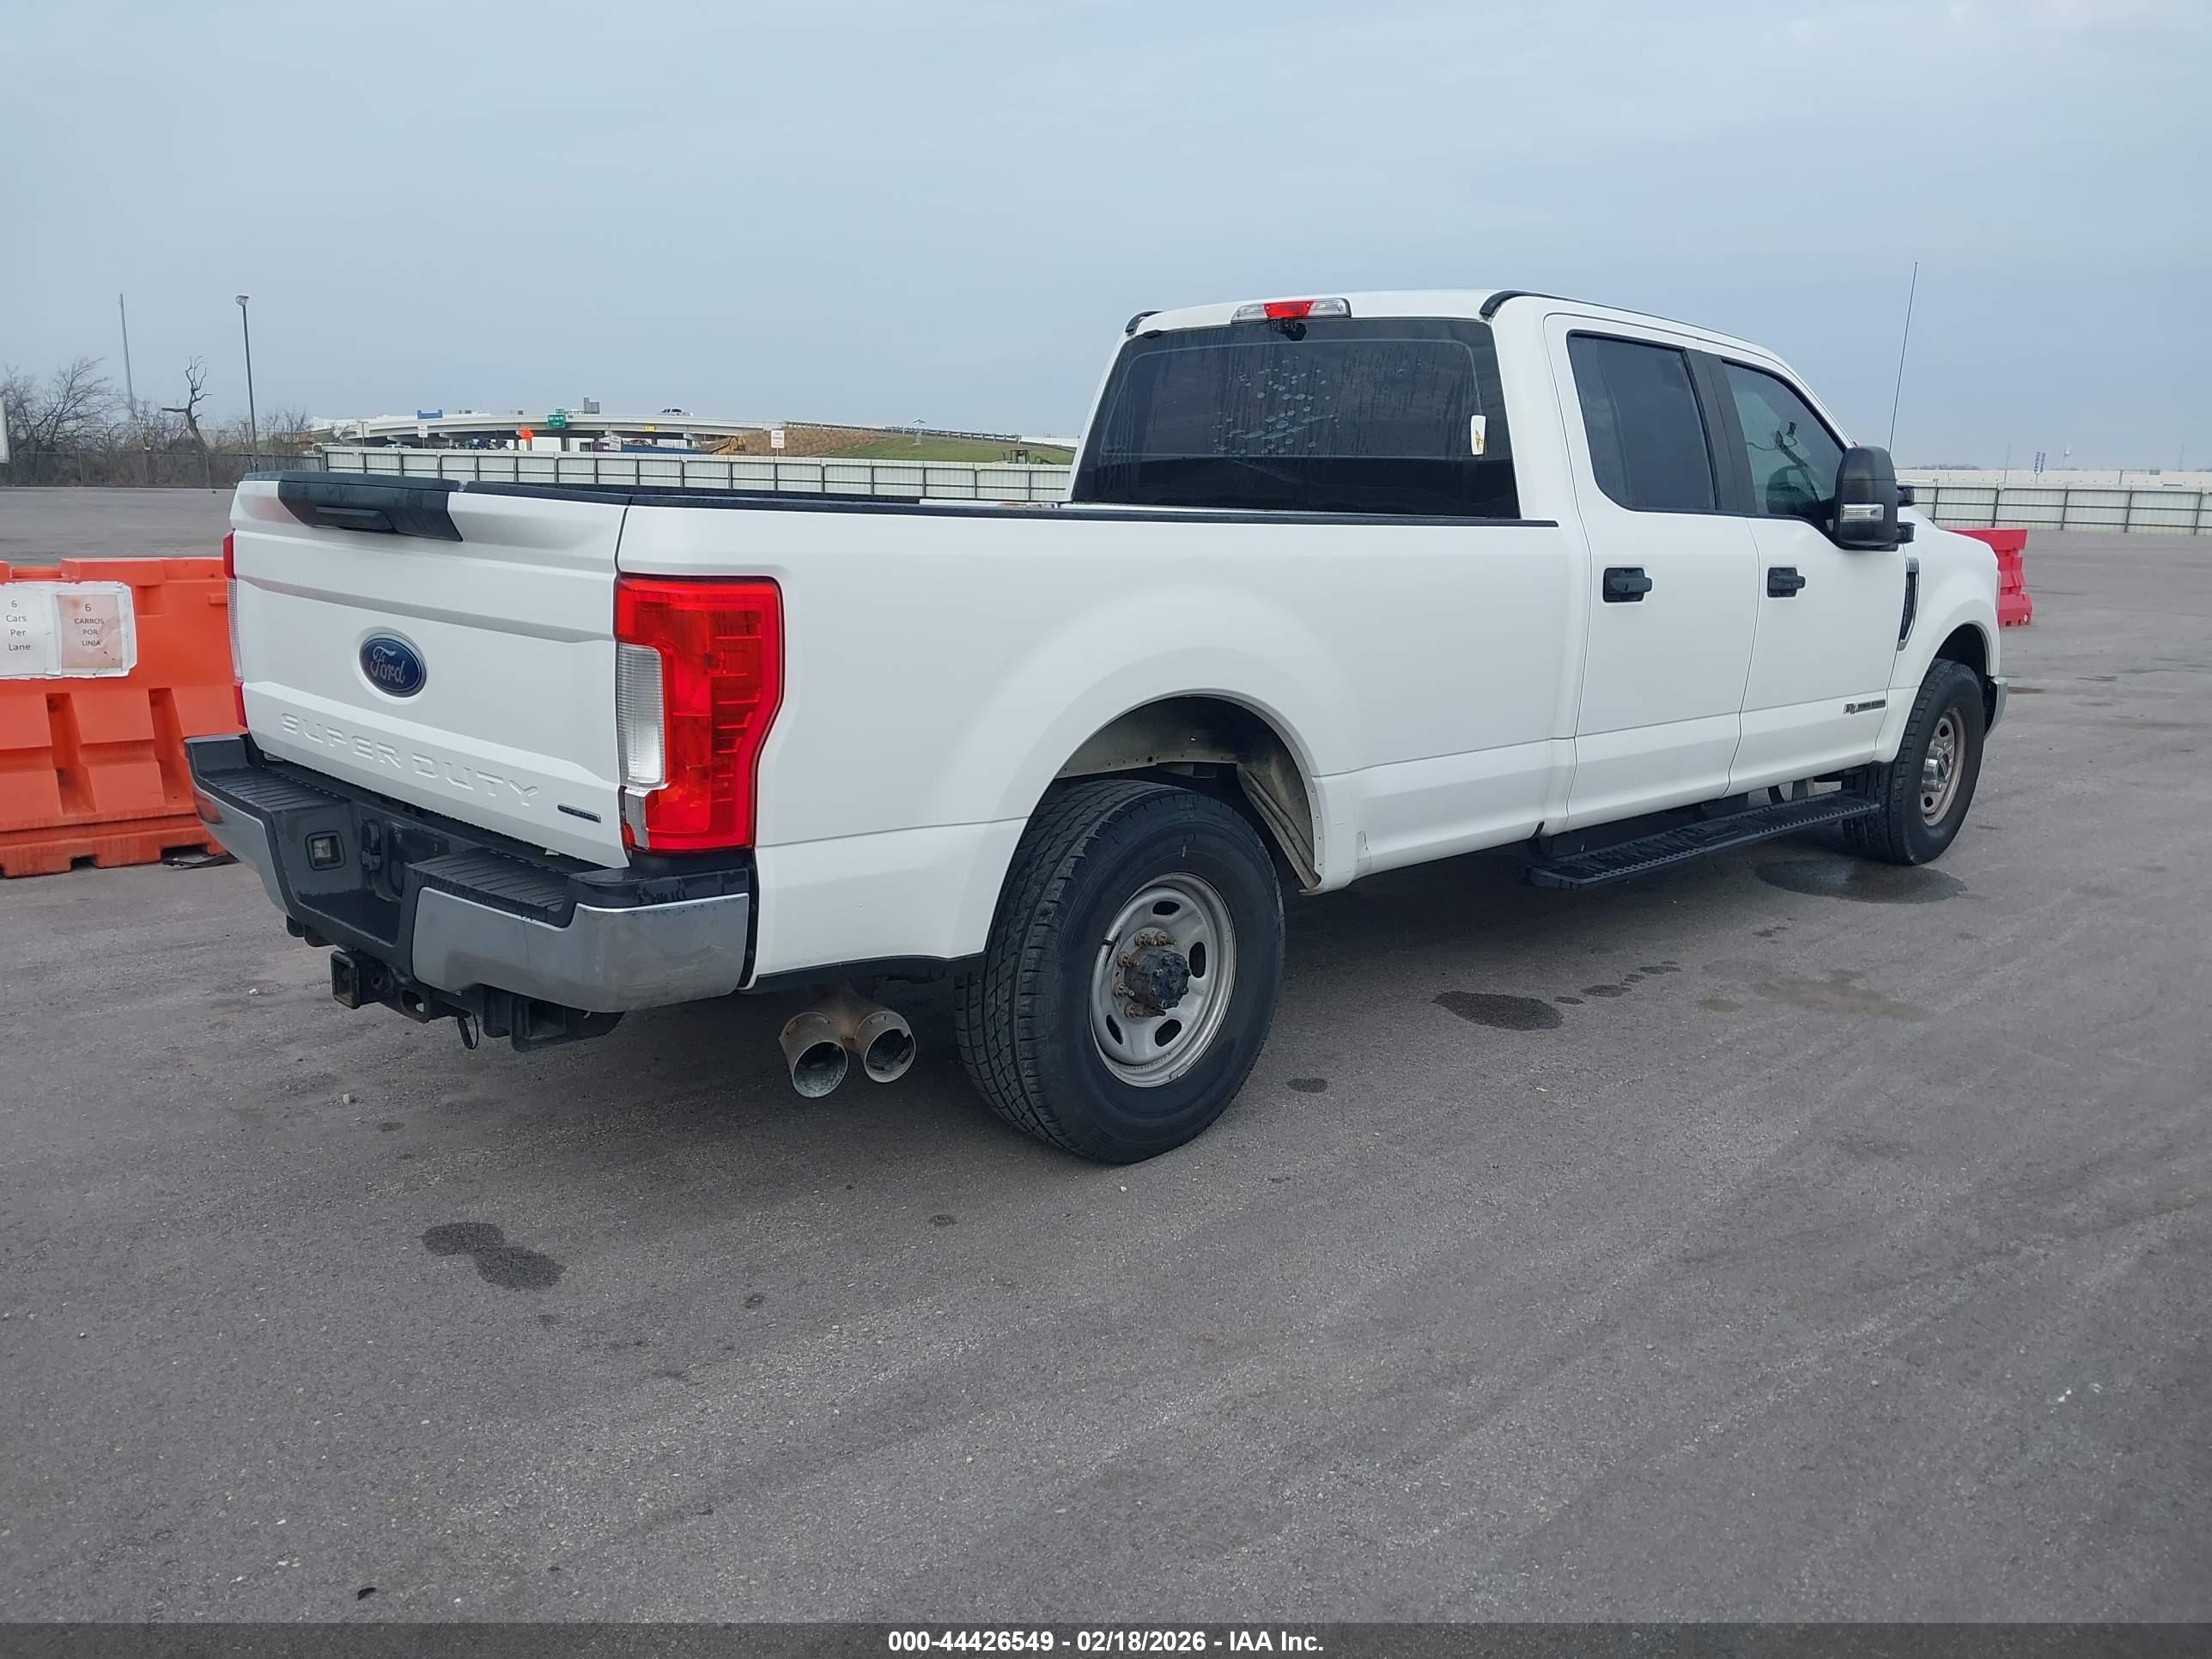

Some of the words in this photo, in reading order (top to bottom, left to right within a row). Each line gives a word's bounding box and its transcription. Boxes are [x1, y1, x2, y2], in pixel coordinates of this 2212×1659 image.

[11, 599, 17, 608] 6
[371, 647, 404, 684] Ford
[281, 713, 402, 769] SUPER
[412, 752, 538, 806] DUTY
